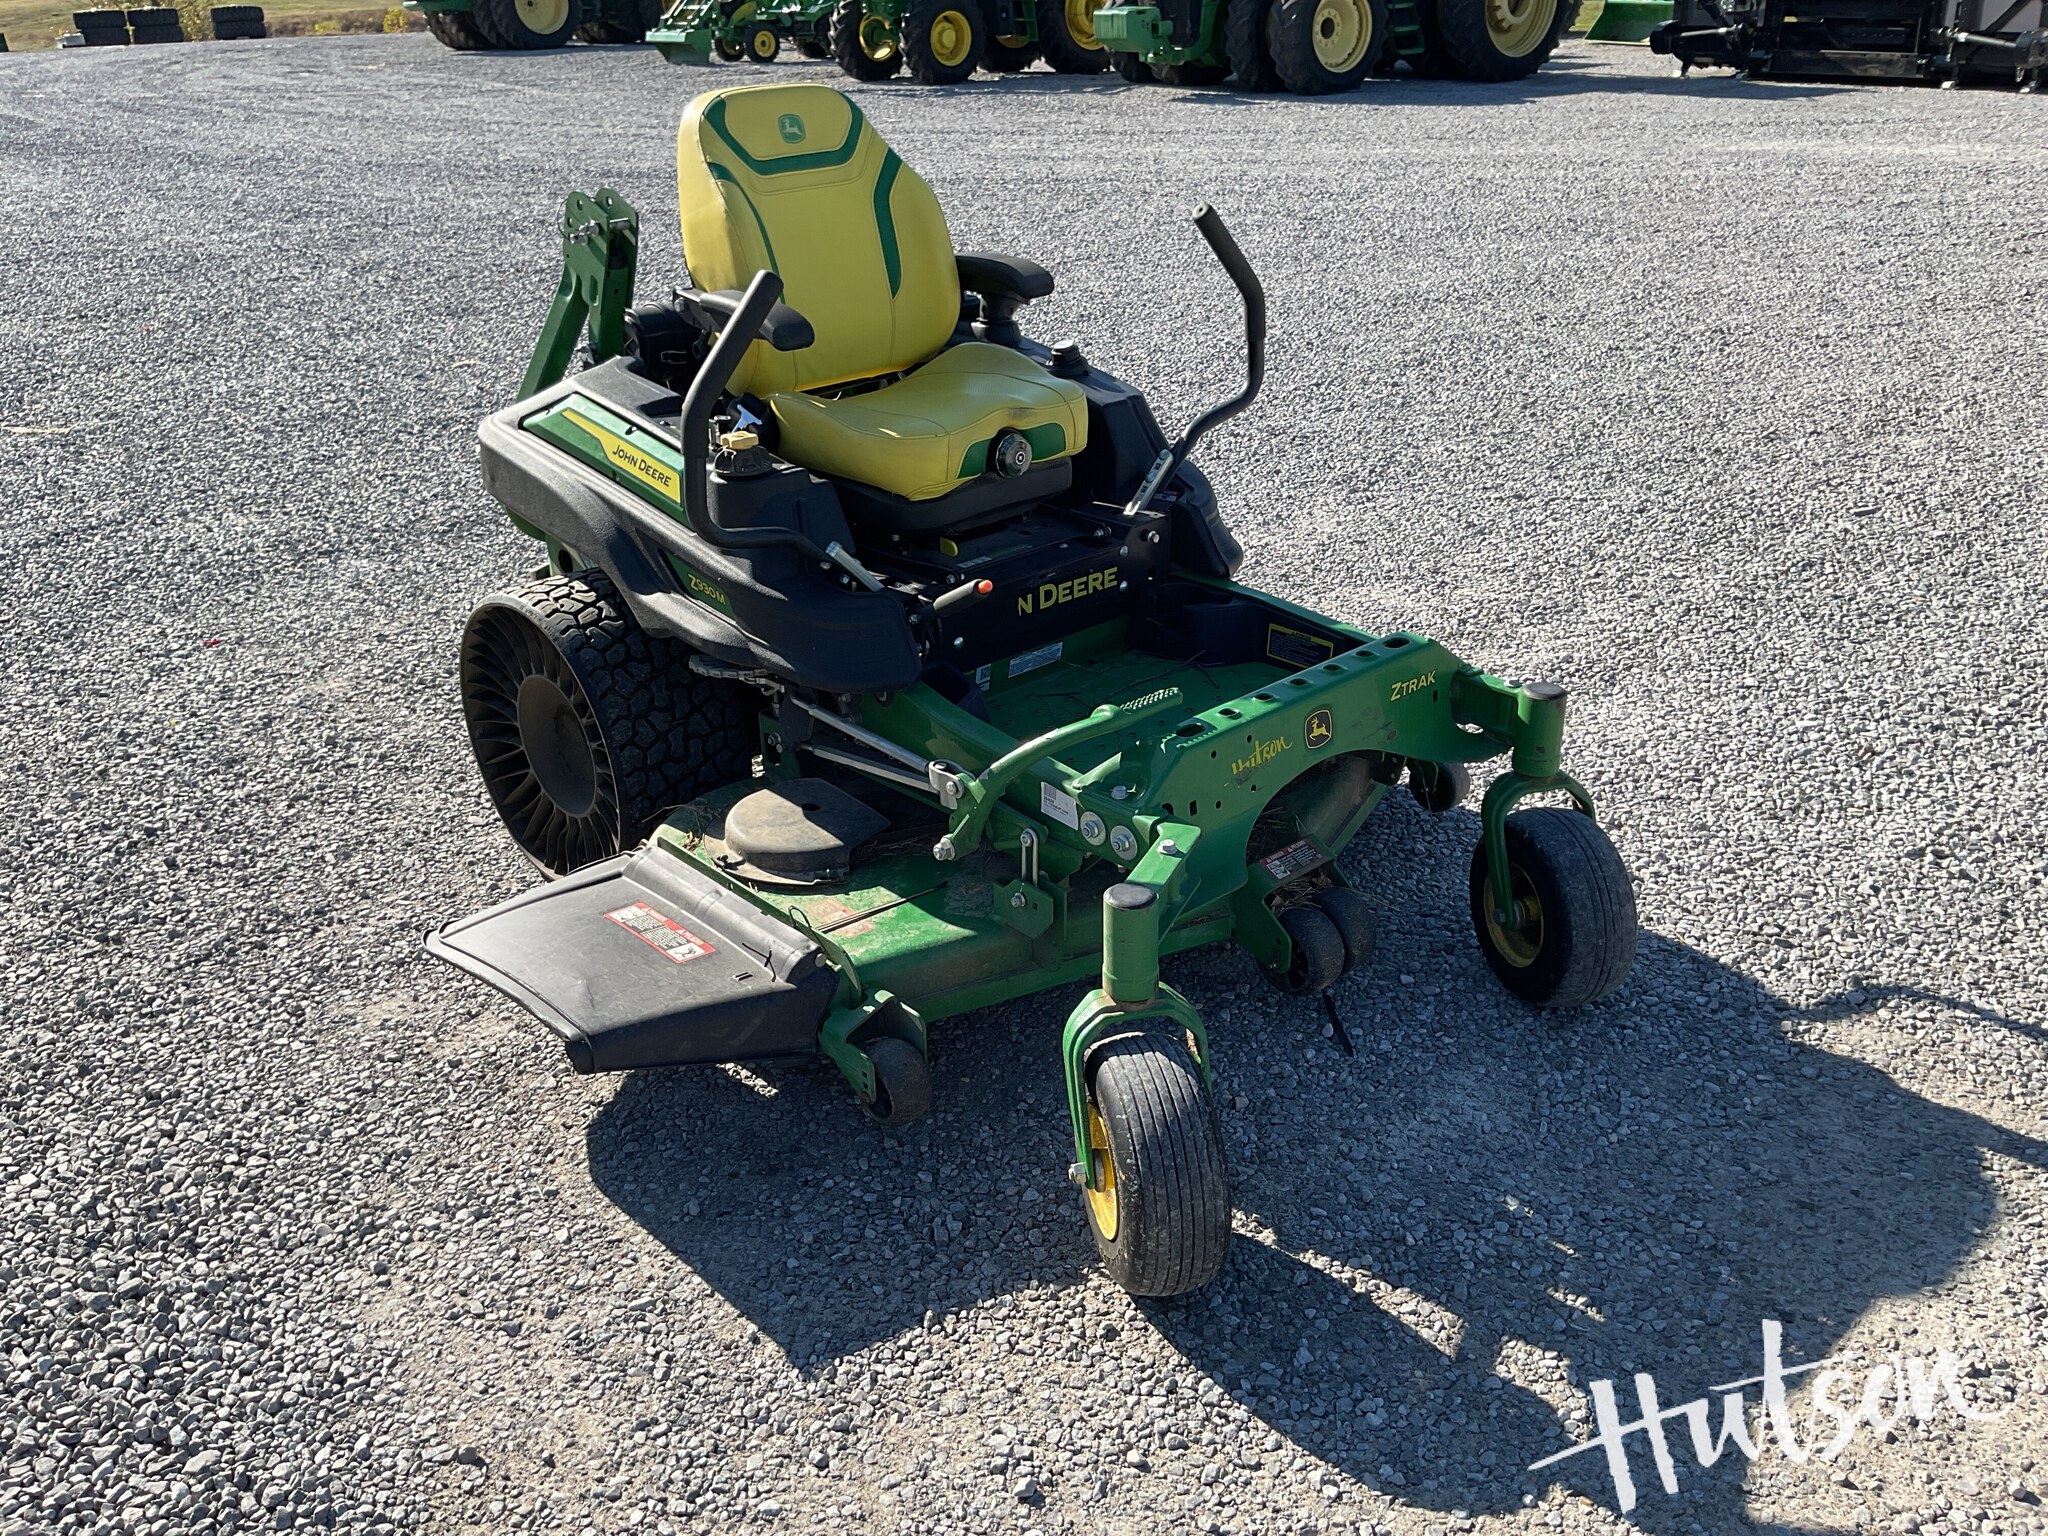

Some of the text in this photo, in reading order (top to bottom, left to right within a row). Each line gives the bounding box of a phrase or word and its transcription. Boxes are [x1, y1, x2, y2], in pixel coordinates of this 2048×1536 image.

[612, 444, 672, 487] JOHN DEERE
[688, 573, 726, 605] Z930M
[1040, 566, 1118, 610] DEERE
[1391, 670, 1436, 701] ZTRAK
